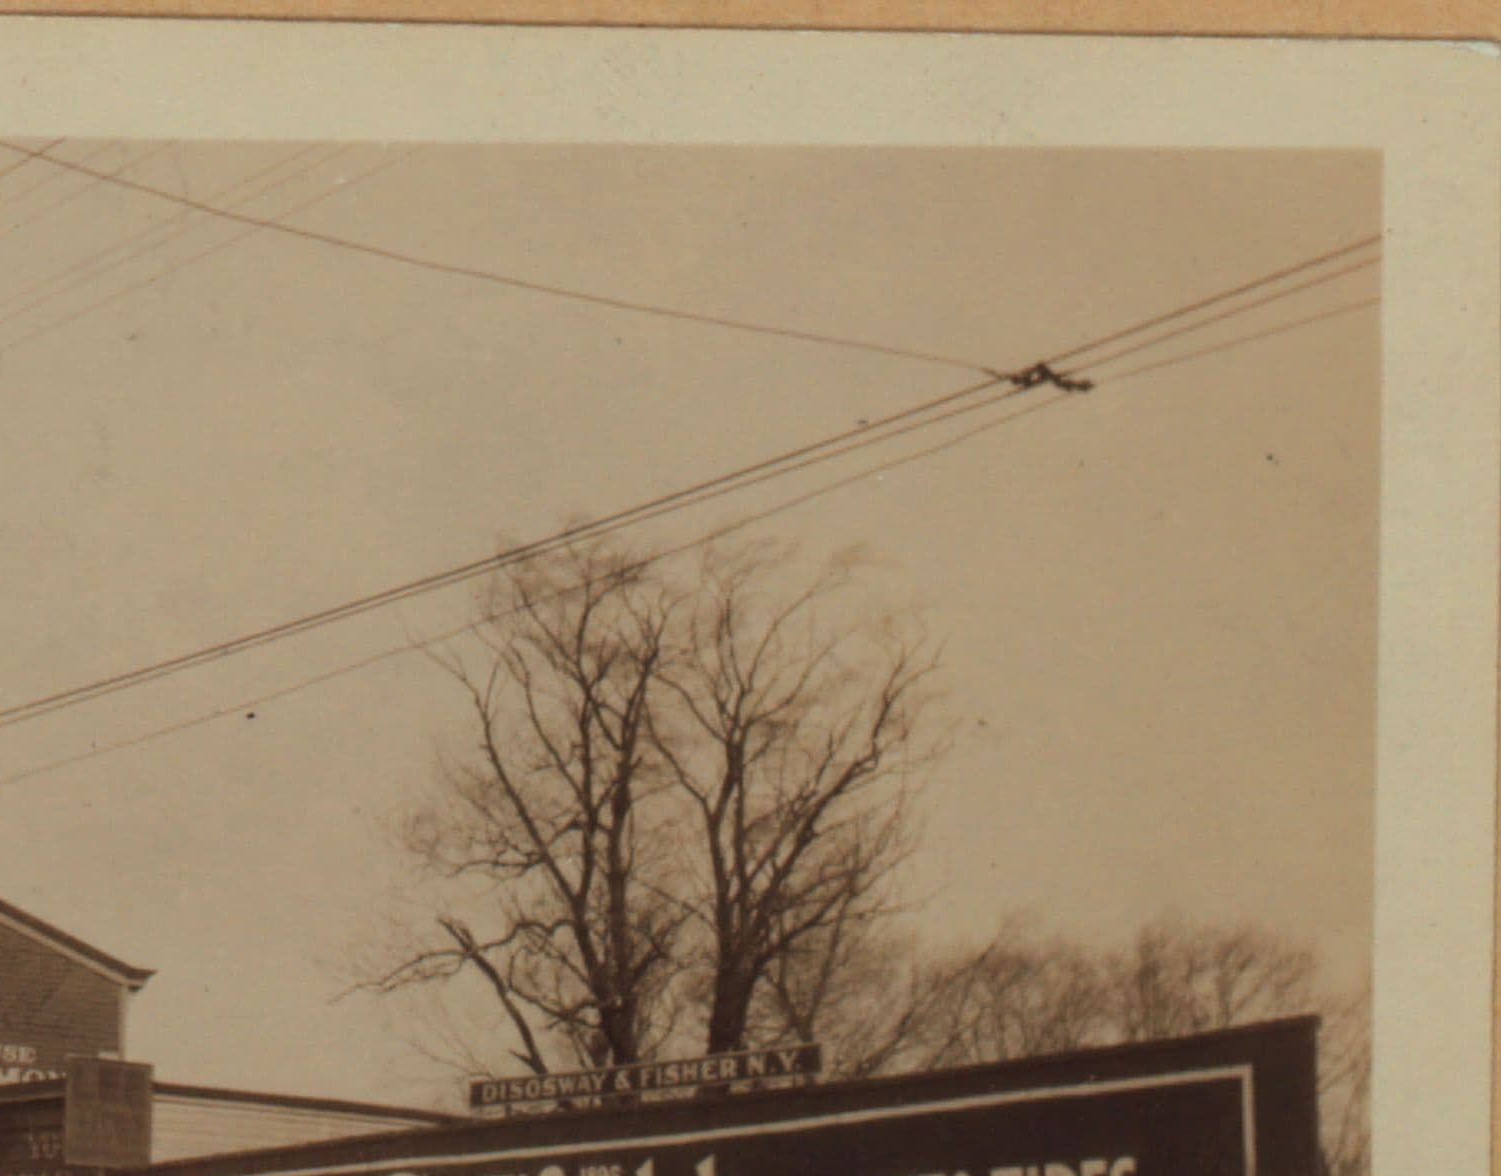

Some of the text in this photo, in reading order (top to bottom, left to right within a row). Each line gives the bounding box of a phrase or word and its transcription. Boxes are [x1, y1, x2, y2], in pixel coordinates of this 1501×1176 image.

[482, 1073, 605, 1101] DISOSWAY
[614, 1070, 630, 1090] &
[640, 1058, 737, 1089] FISHER
